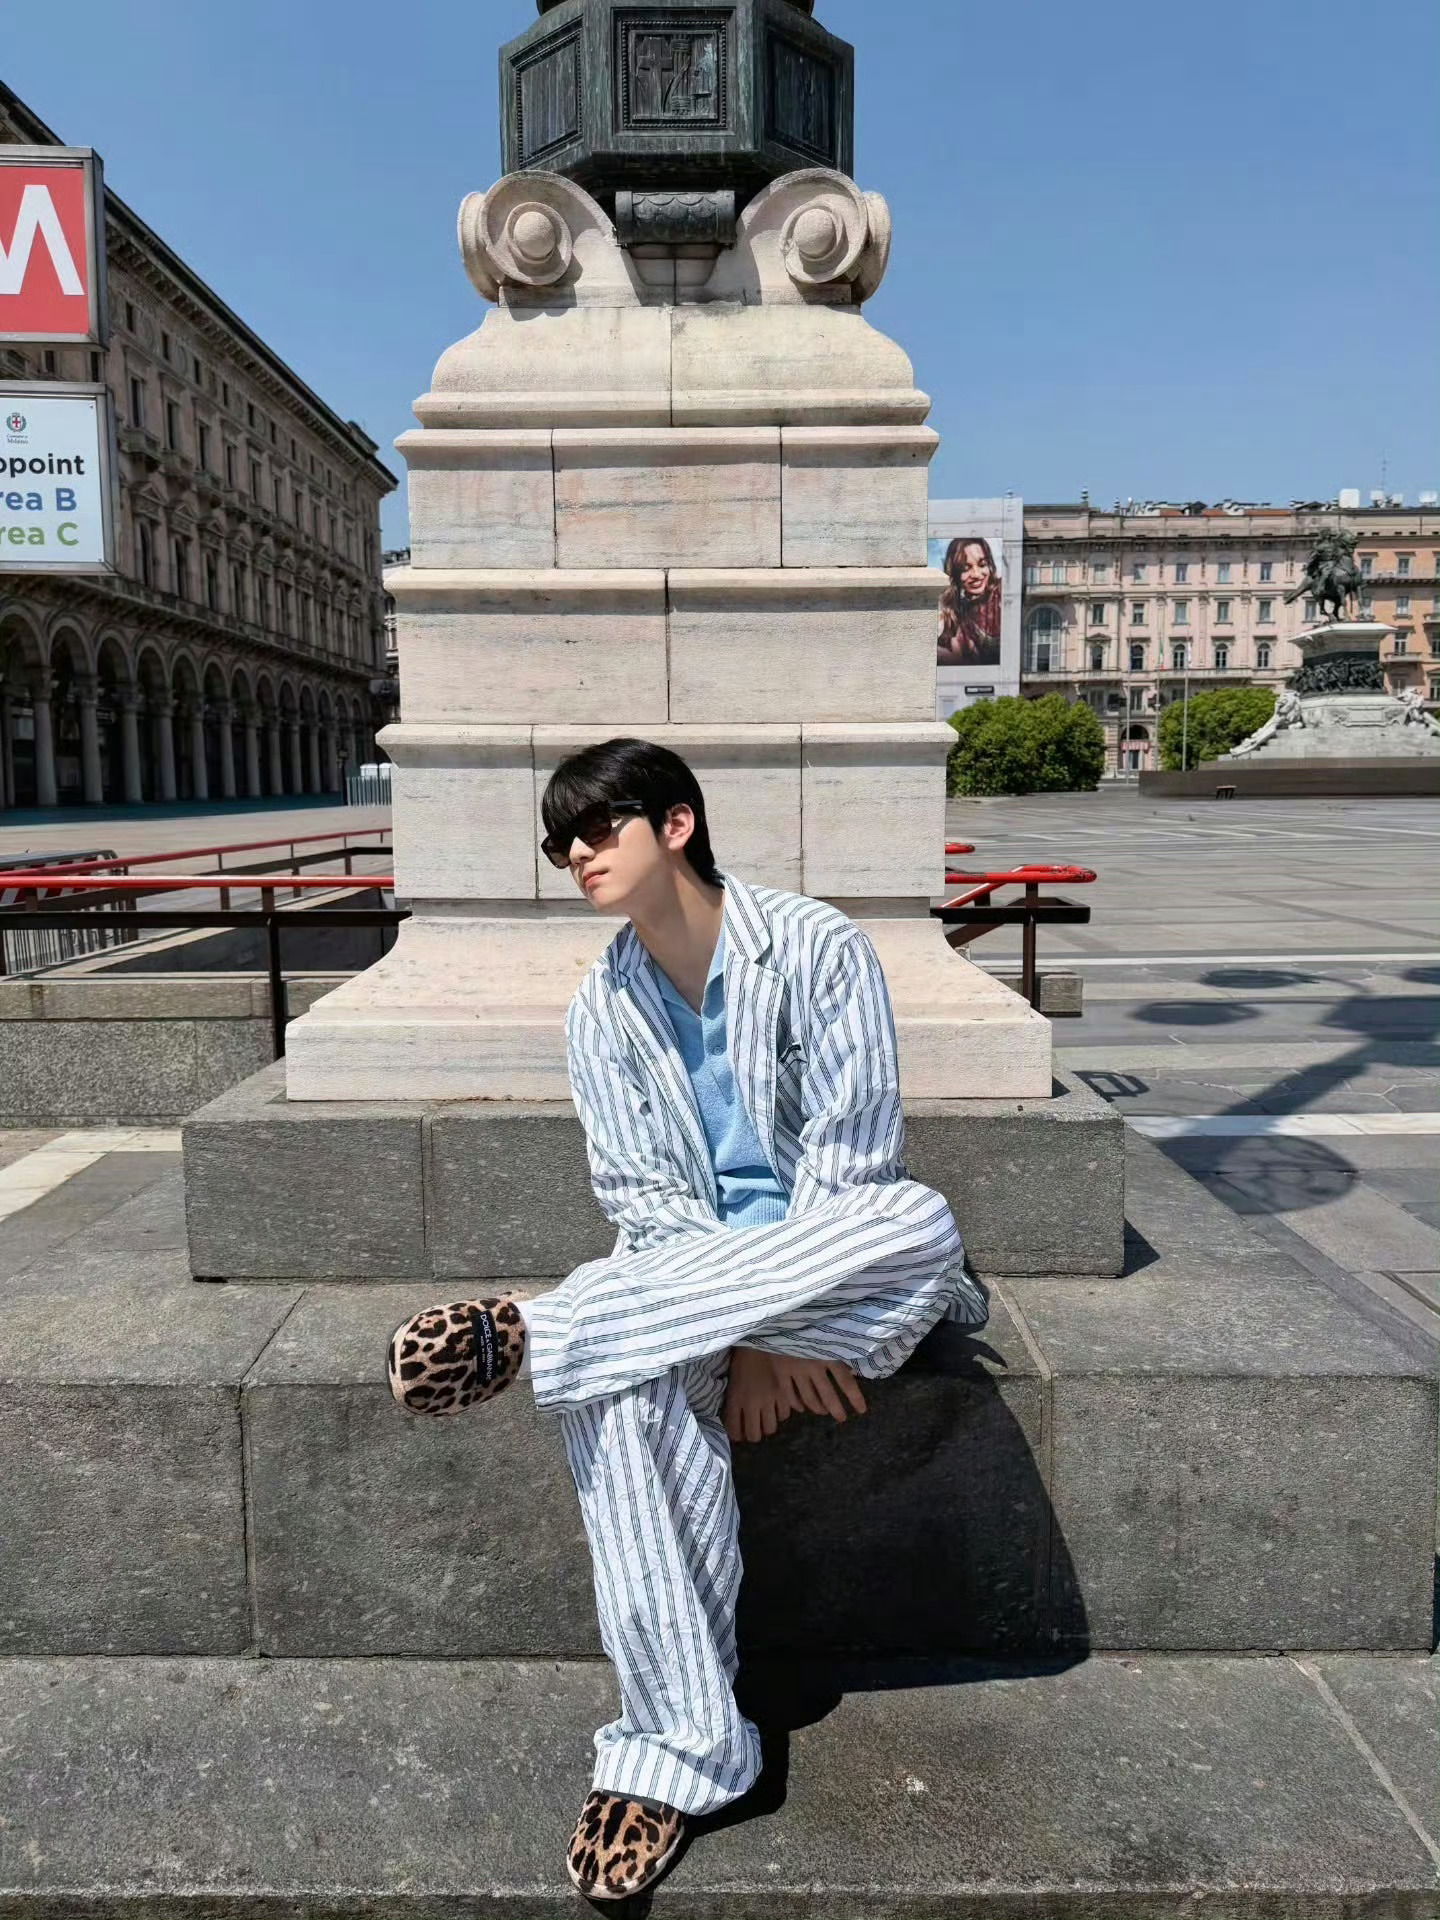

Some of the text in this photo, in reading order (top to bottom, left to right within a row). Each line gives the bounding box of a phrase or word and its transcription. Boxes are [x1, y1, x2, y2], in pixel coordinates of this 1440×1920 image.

[0, 184, 85, 295] M
[55, 487, 77, 512] B
[57, 522, 79, 546] C
[480, 1314, 492, 1339] DOLCE
